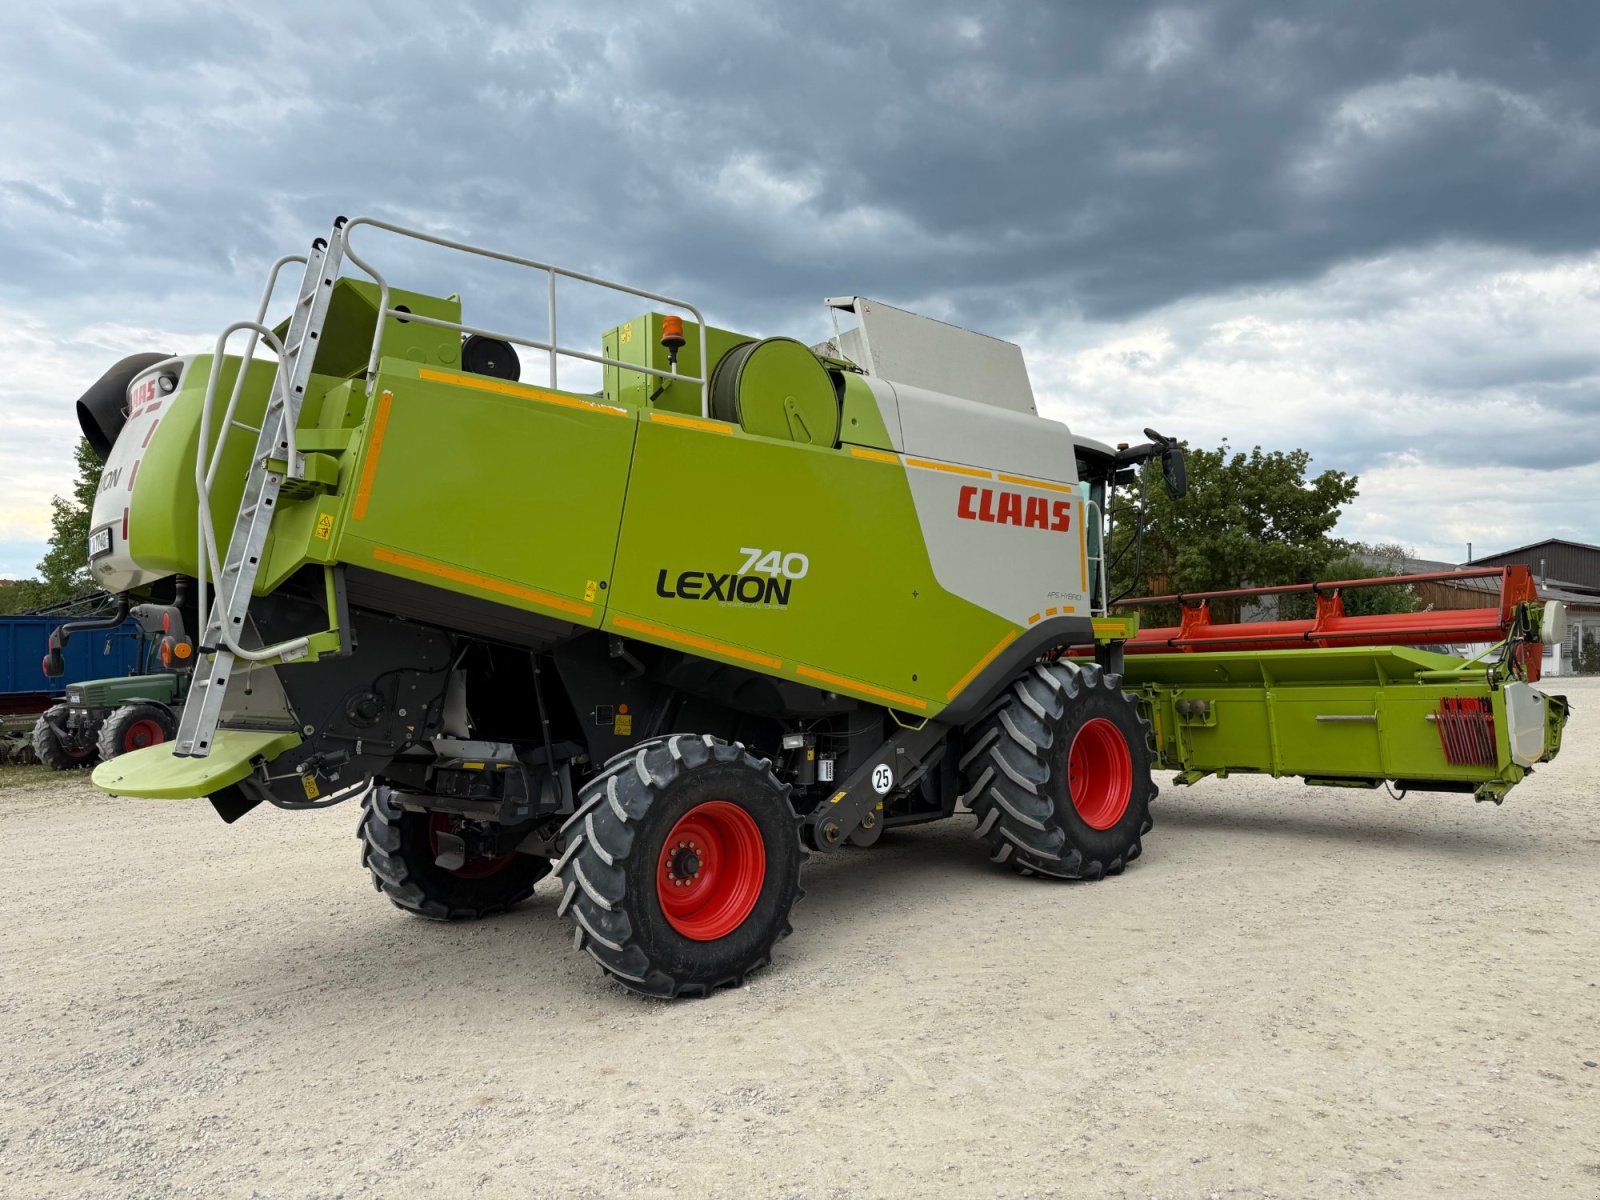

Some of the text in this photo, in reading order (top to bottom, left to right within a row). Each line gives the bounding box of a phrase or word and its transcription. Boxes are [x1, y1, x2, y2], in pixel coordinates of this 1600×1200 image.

[957, 485, 1071, 532] CLAAS
[736, 547, 809, 579] 740
[656, 569, 792, 605] LEXION
[876, 769, 889, 788] 25
